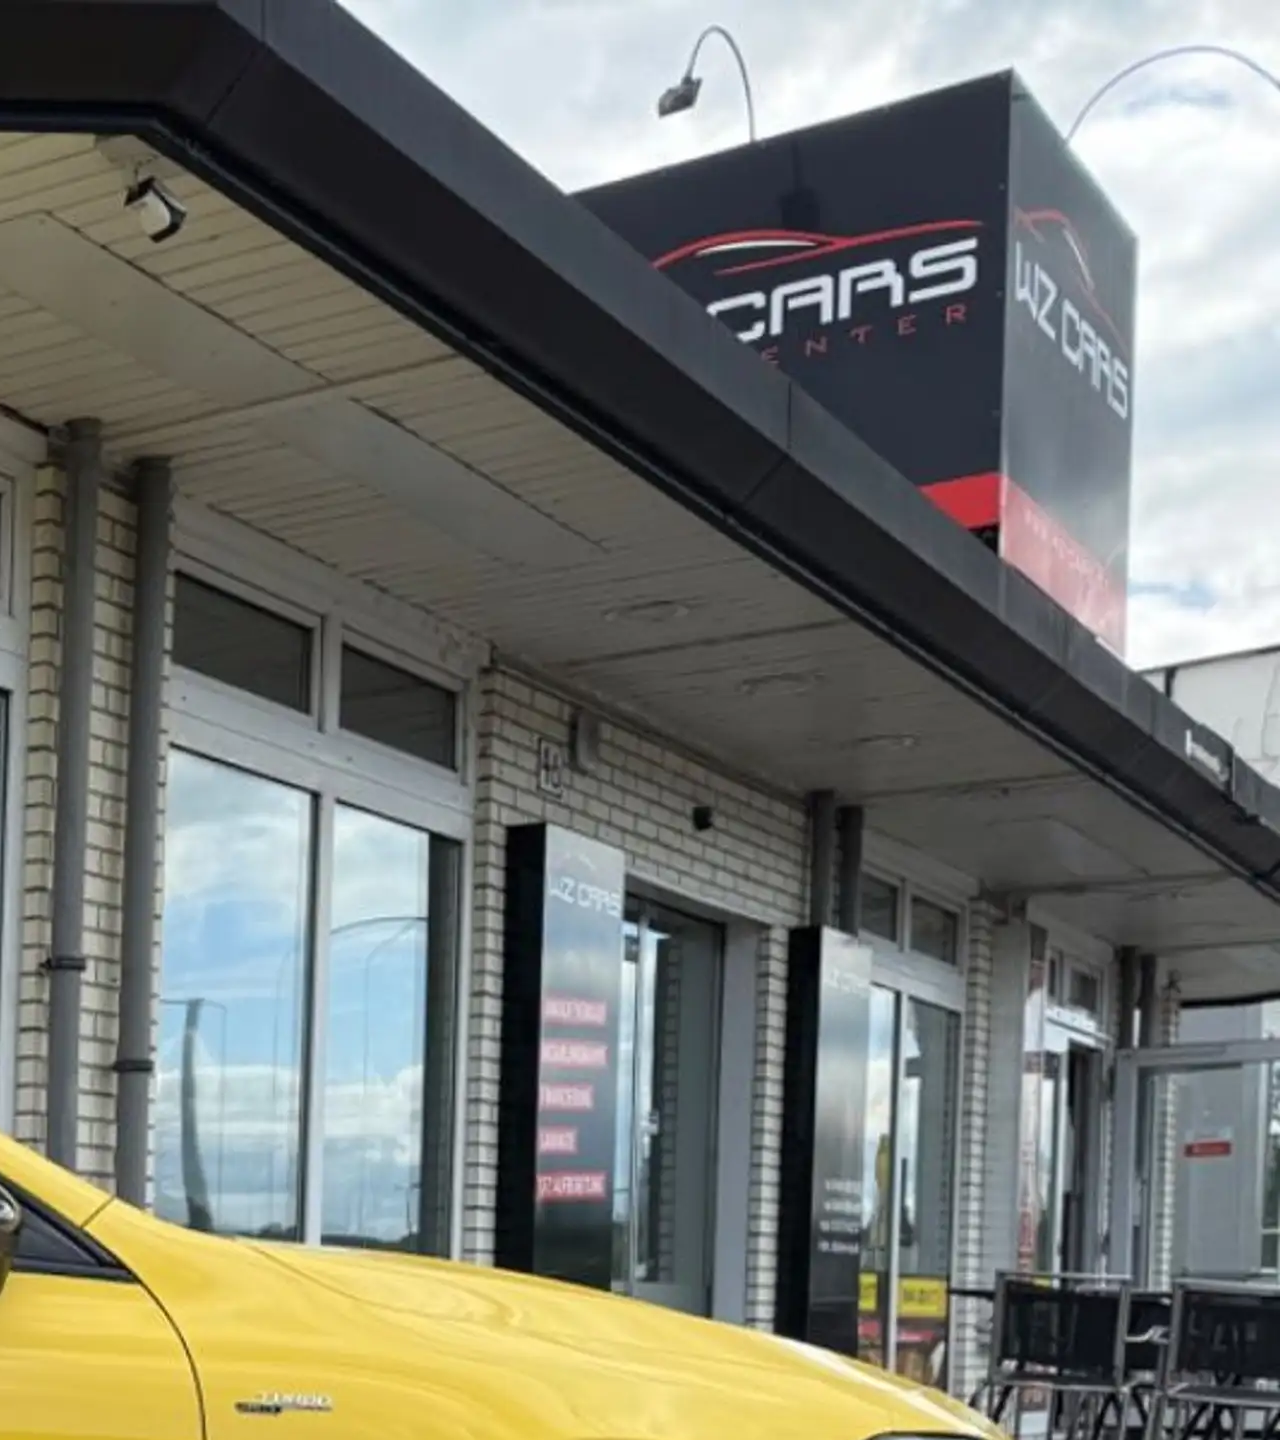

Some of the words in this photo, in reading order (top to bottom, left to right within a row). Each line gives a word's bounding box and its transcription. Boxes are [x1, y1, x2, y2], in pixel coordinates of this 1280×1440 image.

[706, 237, 978, 343] CARS
[1015, 240, 1058, 342] WZ
[1061, 298, 1130, 420] CARS
